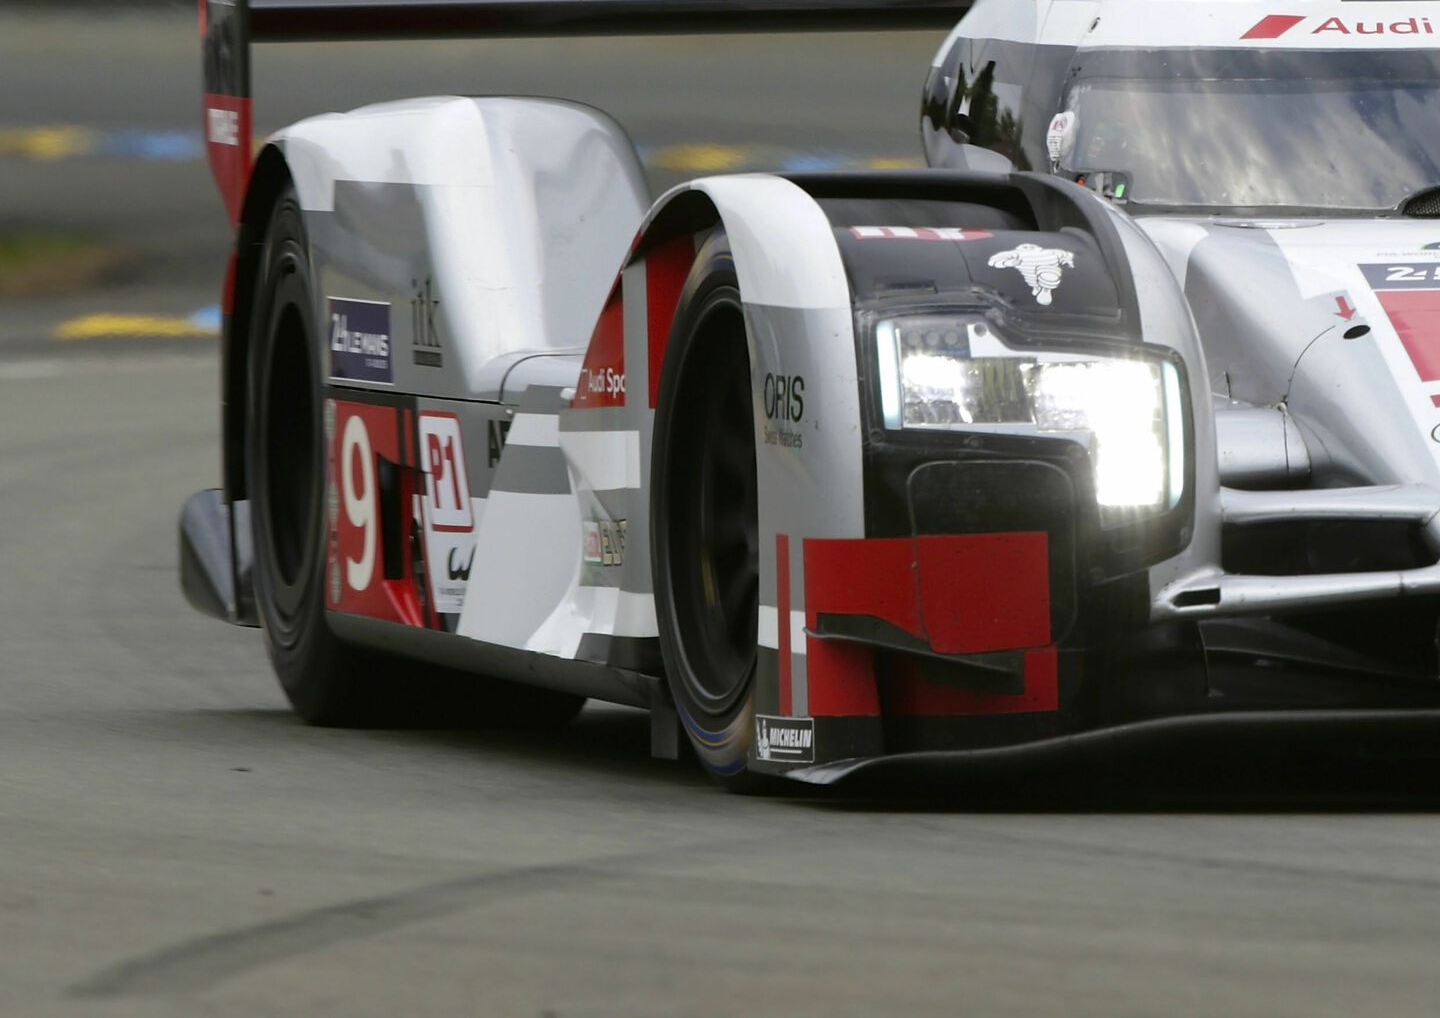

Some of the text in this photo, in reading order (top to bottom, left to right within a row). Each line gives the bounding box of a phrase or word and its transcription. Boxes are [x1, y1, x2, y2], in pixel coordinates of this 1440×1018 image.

[1311, 16, 1434, 35] Audi
[764, 372, 804, 423] ORIS
[427, 433, 463, 510] P1
[341, 415, 376, 591] 9
[769, 727, 812, 749] MICHELIN
